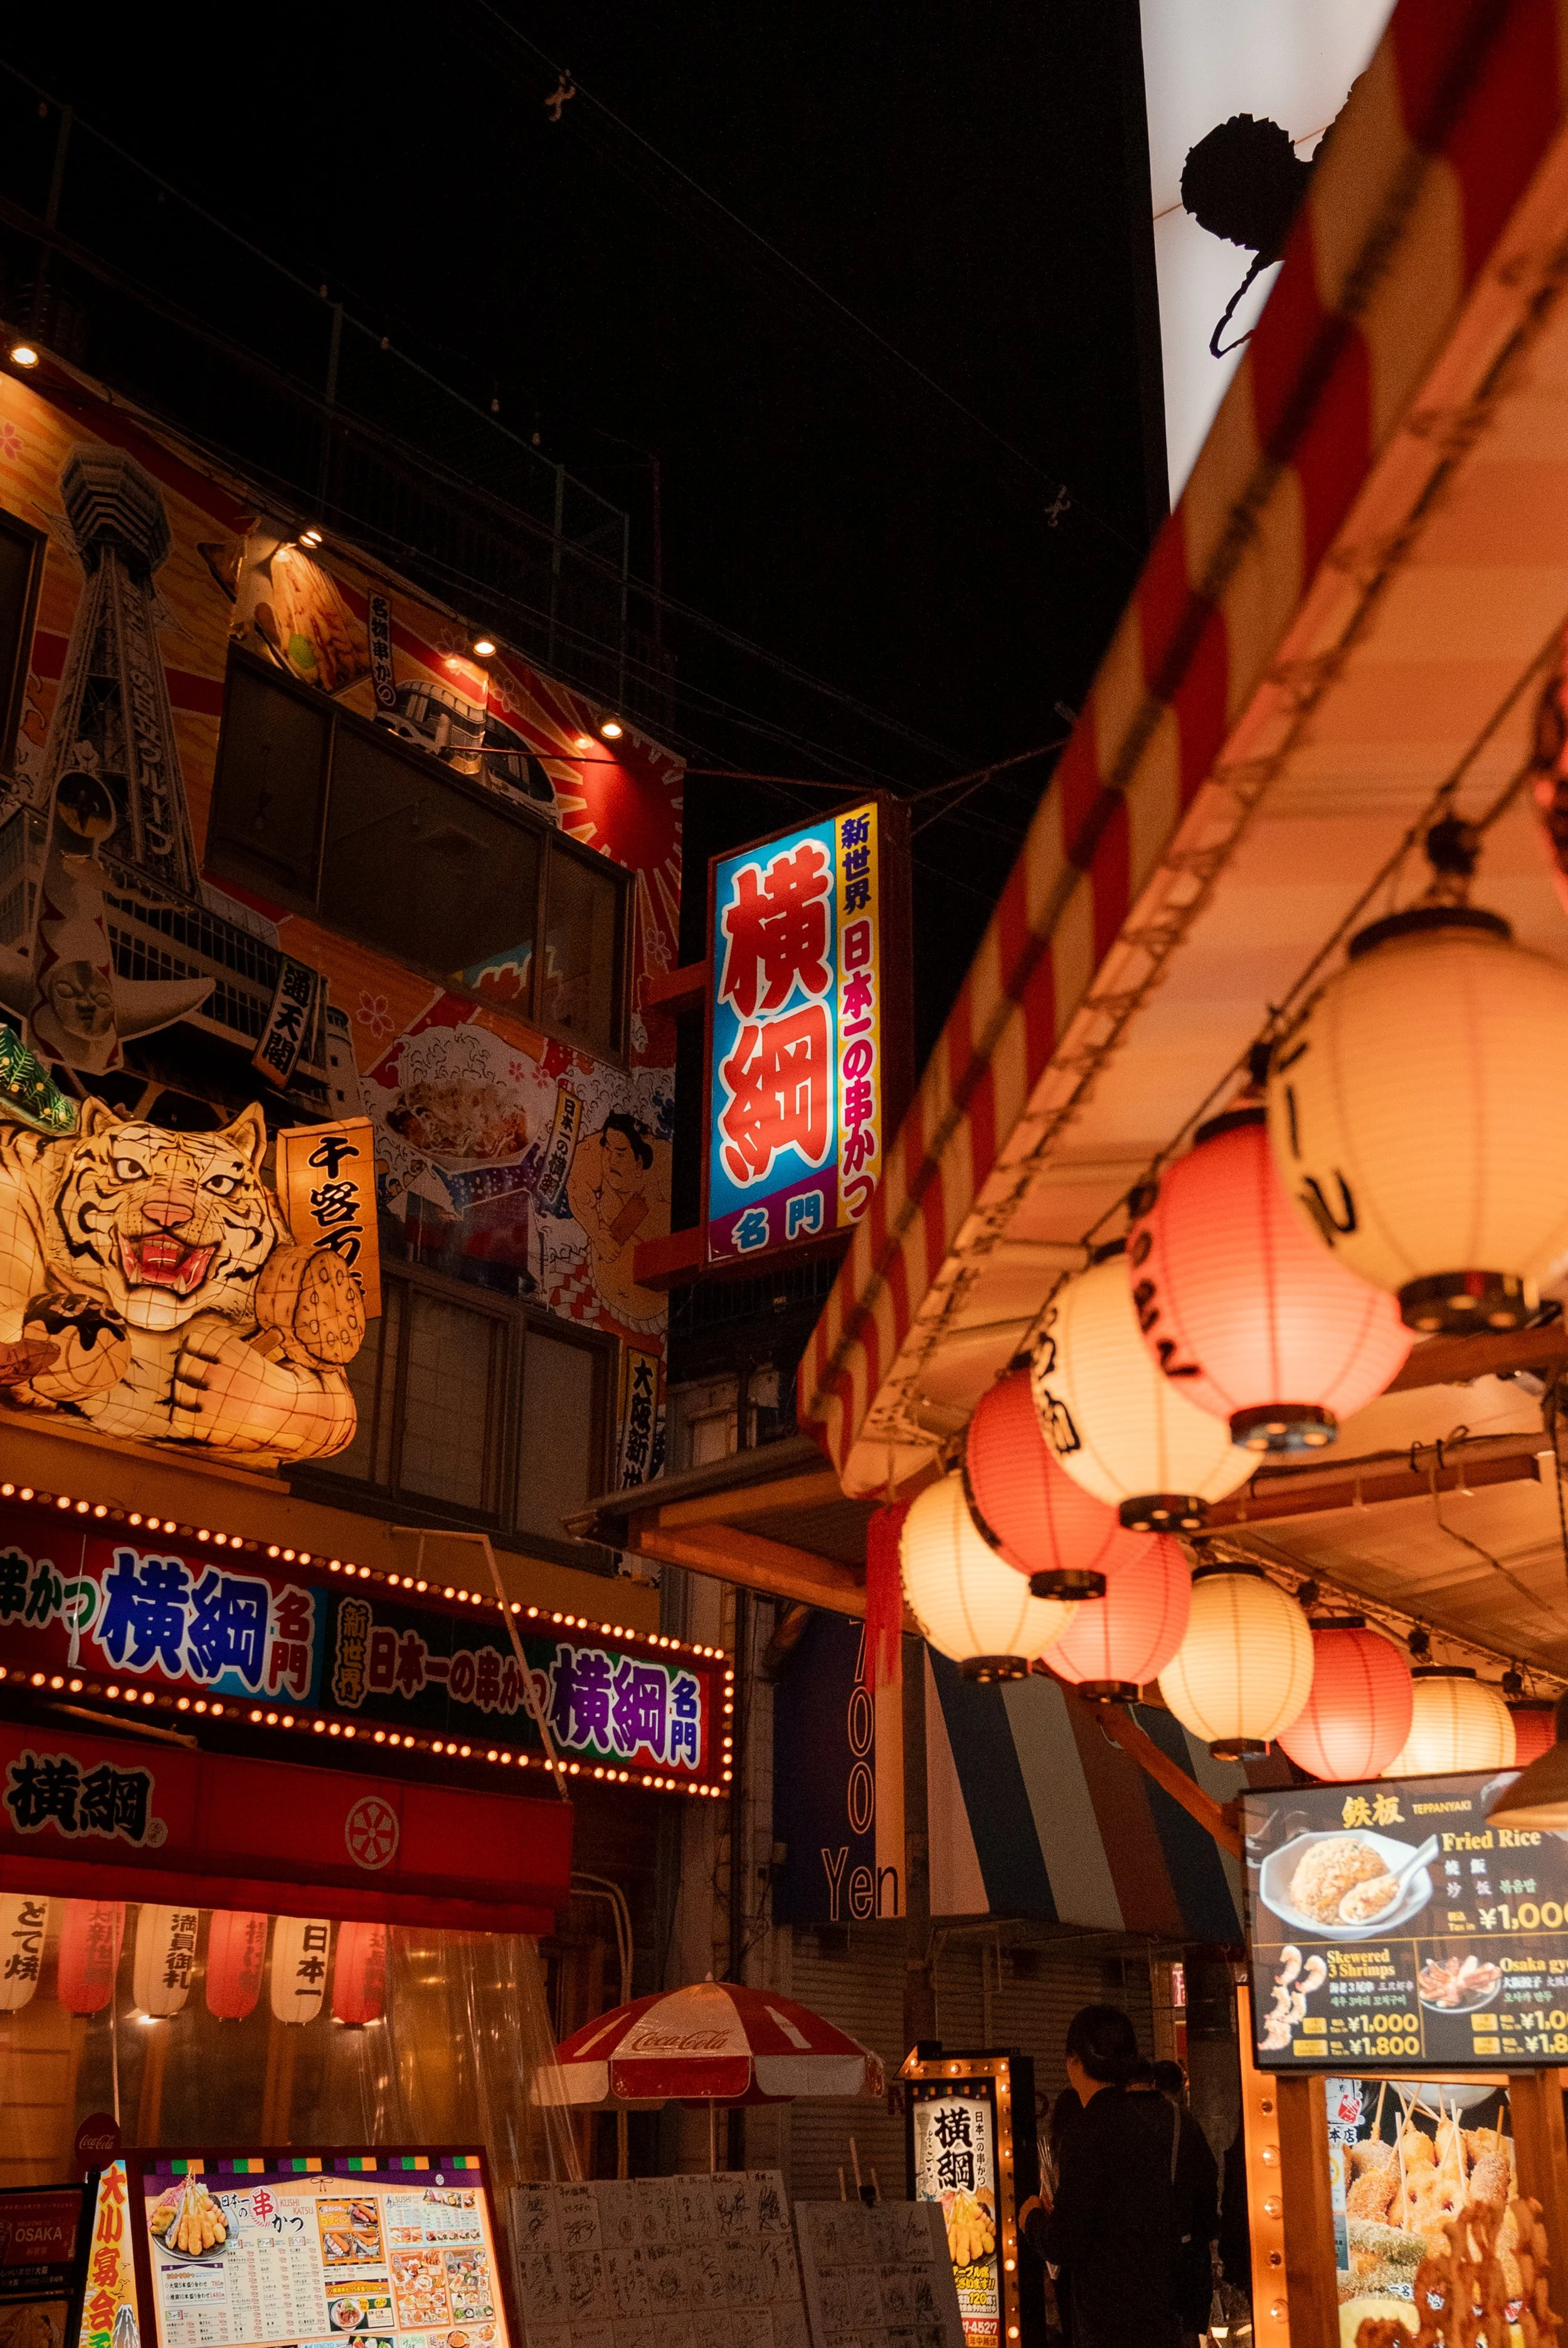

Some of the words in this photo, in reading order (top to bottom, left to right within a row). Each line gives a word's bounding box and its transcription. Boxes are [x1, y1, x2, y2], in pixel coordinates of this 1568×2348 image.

[840, 812, 872, 915] 新世界
[262, 962, 311, 1076] 通天閣
[721, 844, 829, 1183] 横綱
[842, 920, 875, 1219] 日本一の串かつ
[731, 1191, 822, 1252] 名門
[0, 1552, 96, 1627] 串かつ
[99, 1553, 270, 1686] 横綱
[268, 1591, 311, 1694] 名門
[338, 1602, 368, 1701] 新世界
[369, 1631, 549, 1715] 日本一の串かつ
[549, 1647, 669, 1761] 横綱
[670, 1674, 698, 1763] 名門
[8, 1755, 152, 1842] 横綱
[1342, 1793, 1406, 1829] 鉄板
[1412, 1799, 1473, 1815] TEPPANYAKI
[1441, 1830, 1493, 1852] Fried
[1498, 1829, 1542, 1847] Rice
[821, 1847, 899, 1921] Yen
[4, 1901, 47, 1981] どて焼
[1478, 1901, 1568, 1930] ¥1,00
[295, 1924, 327, 1996] 日本一
[1327, 1948, 1391, 1963] Skewered
[1328, 1964, 1337, 1977] 3
[1339, 1963, 1396, 1980] Shrimps
[1500, 1957, 1546, 1972] Osaka
[1549, 1959, 1568, 1974] gy
[632, 2029, 733, 2052] Coca-Cola
[1347, 2013, 1419, 2032] ¥1,000
[1348, 2036, 1420, 2056] ¥1,800
[79, 2134, 114, 2150] Coca-Cola
[934, 2106, 974, 2192] 横綱
[975, 2112, 985, 2185] 日本一の串かつ
[1329, 2128, 1355, 2143] 本店
[221, 2193, 250, 2208] 日本一
[239, 2207, 247, 2218] の
[252, 2188, 274, 2222] 串
[272, 2214, 304, 2233] かつ
[280, 2198, 299, 2207] KUSHI
[15, 2227, 62, 2242] OSAKA
[88, 2165, 126, 2332] 大小宴会
